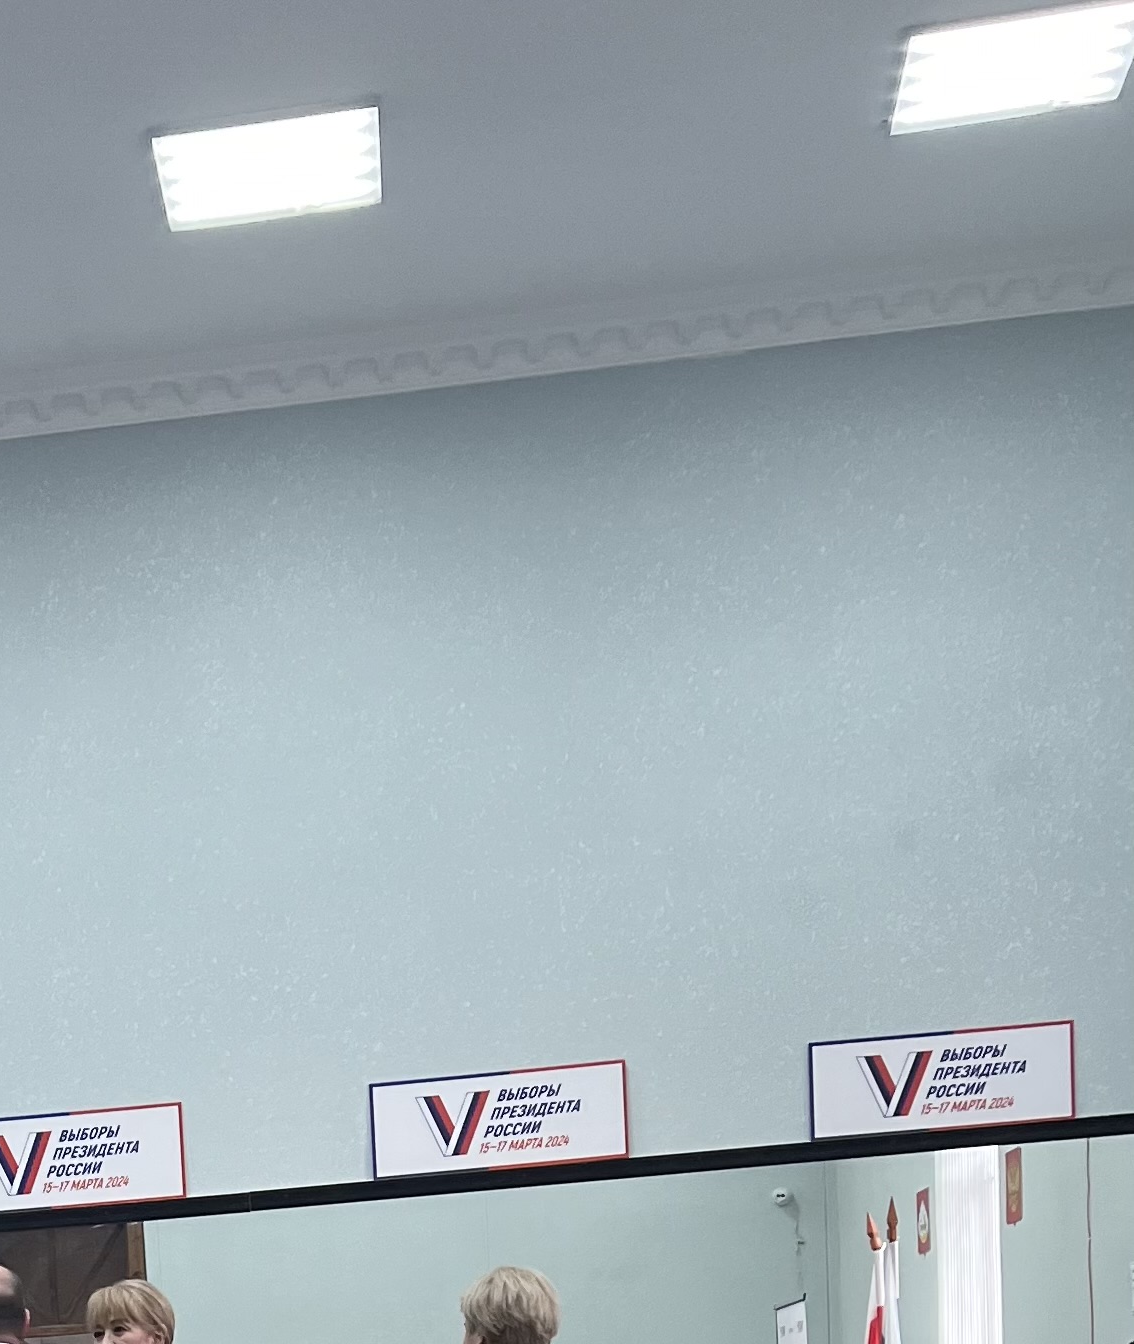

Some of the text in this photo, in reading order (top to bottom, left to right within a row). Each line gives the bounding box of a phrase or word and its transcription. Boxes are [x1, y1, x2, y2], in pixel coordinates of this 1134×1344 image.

[940, 1044, 1007, 1063] ВЫБОРЫ
[933, 1060, 1027, 1081] ПРЕЗИДЕНТА
[497, 1083, 562, 1102] ВЫБОРЫ
[926, 1081, 986, 1099] РОССИИ
[490, 1099, 581, 1120] ПРЕЗИДЕНТА
[951, 1098, 986, 1113] МАРТА
[988, 1096, 1014, 1110] 2024
[59, 1125, 120, 1142] ВЫБОРЫ
[484, 1120, 542, 1138] РОССИИ
[53, 1140, 139, 1160] ПРЕЗИДЕНТА
[508, 1137, 542, 1152] МАРТА
[545, 1135, 569, 1148] 2024
[47, 1161, 102, 1178] РОССИИ
[70, 1177, 103, 1191] МАРТА
[105, 1175, 129, 1188] 2024
